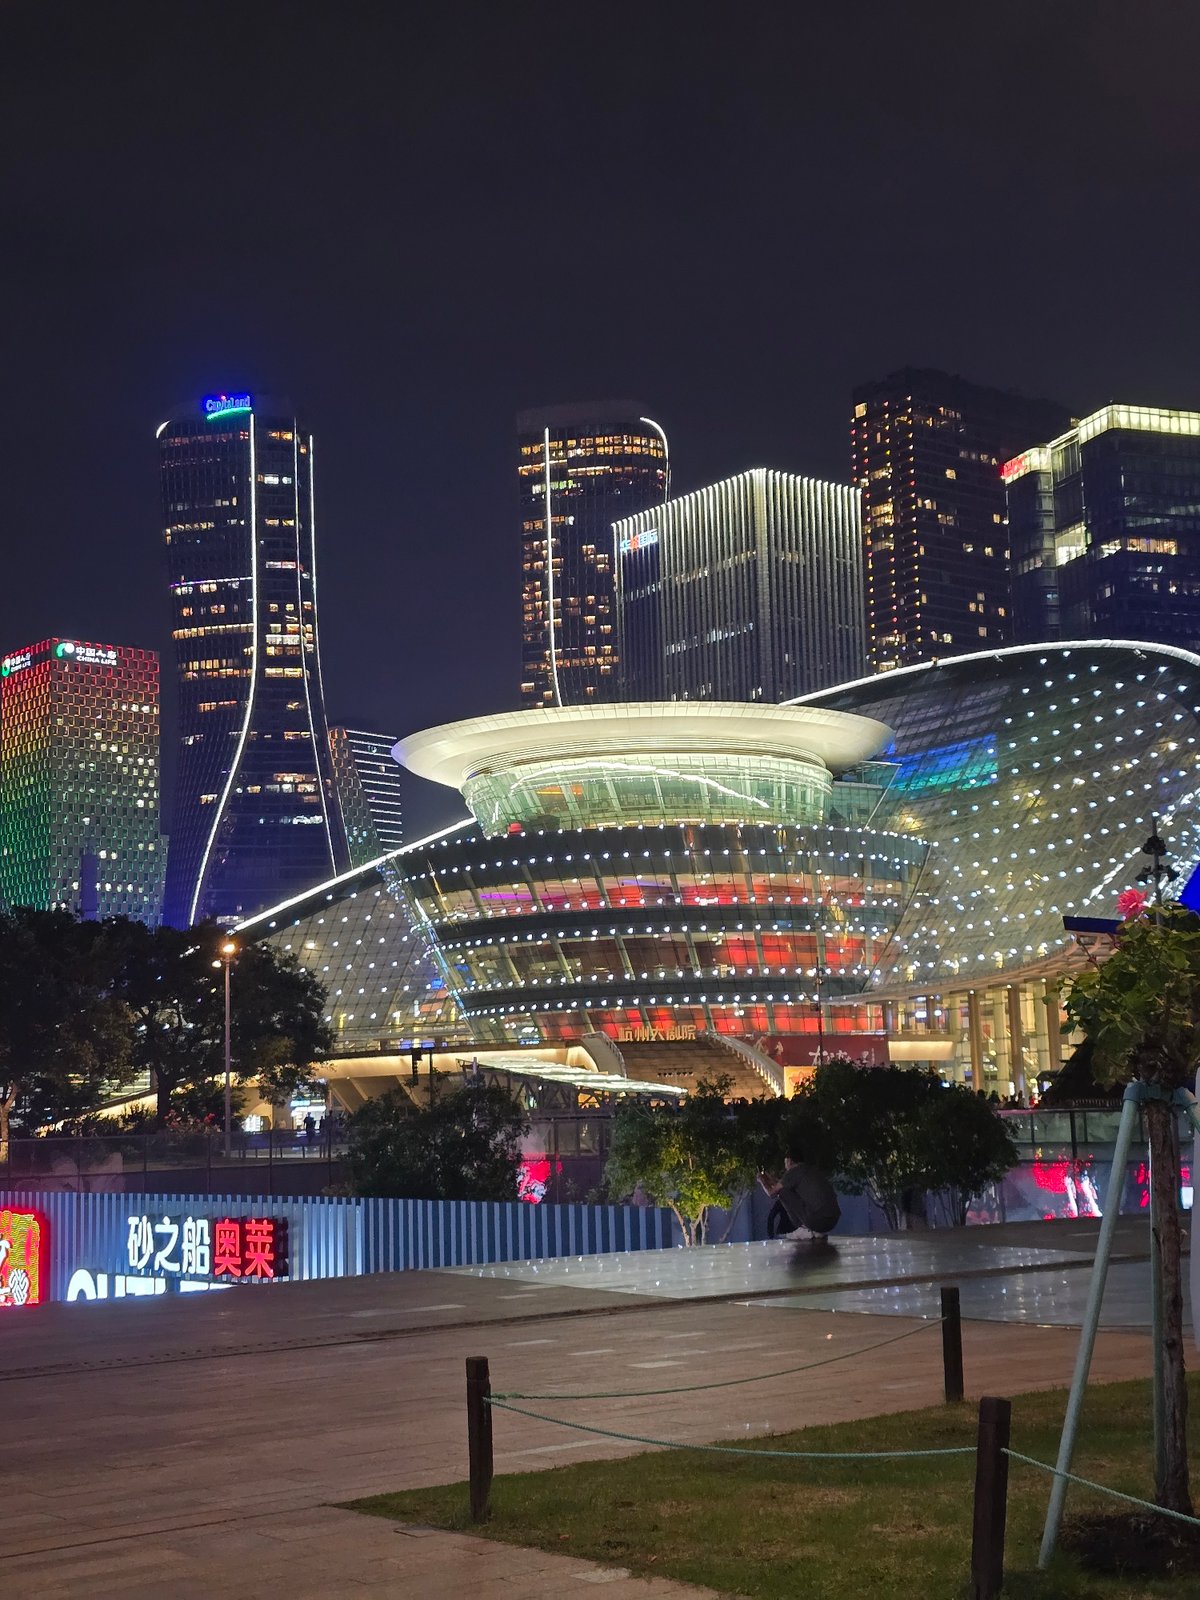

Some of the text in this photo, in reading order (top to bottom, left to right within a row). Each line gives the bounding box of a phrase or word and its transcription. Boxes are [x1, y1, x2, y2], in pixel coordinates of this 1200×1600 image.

[127, 1215, 275, 1278] 砂之船奥莱
